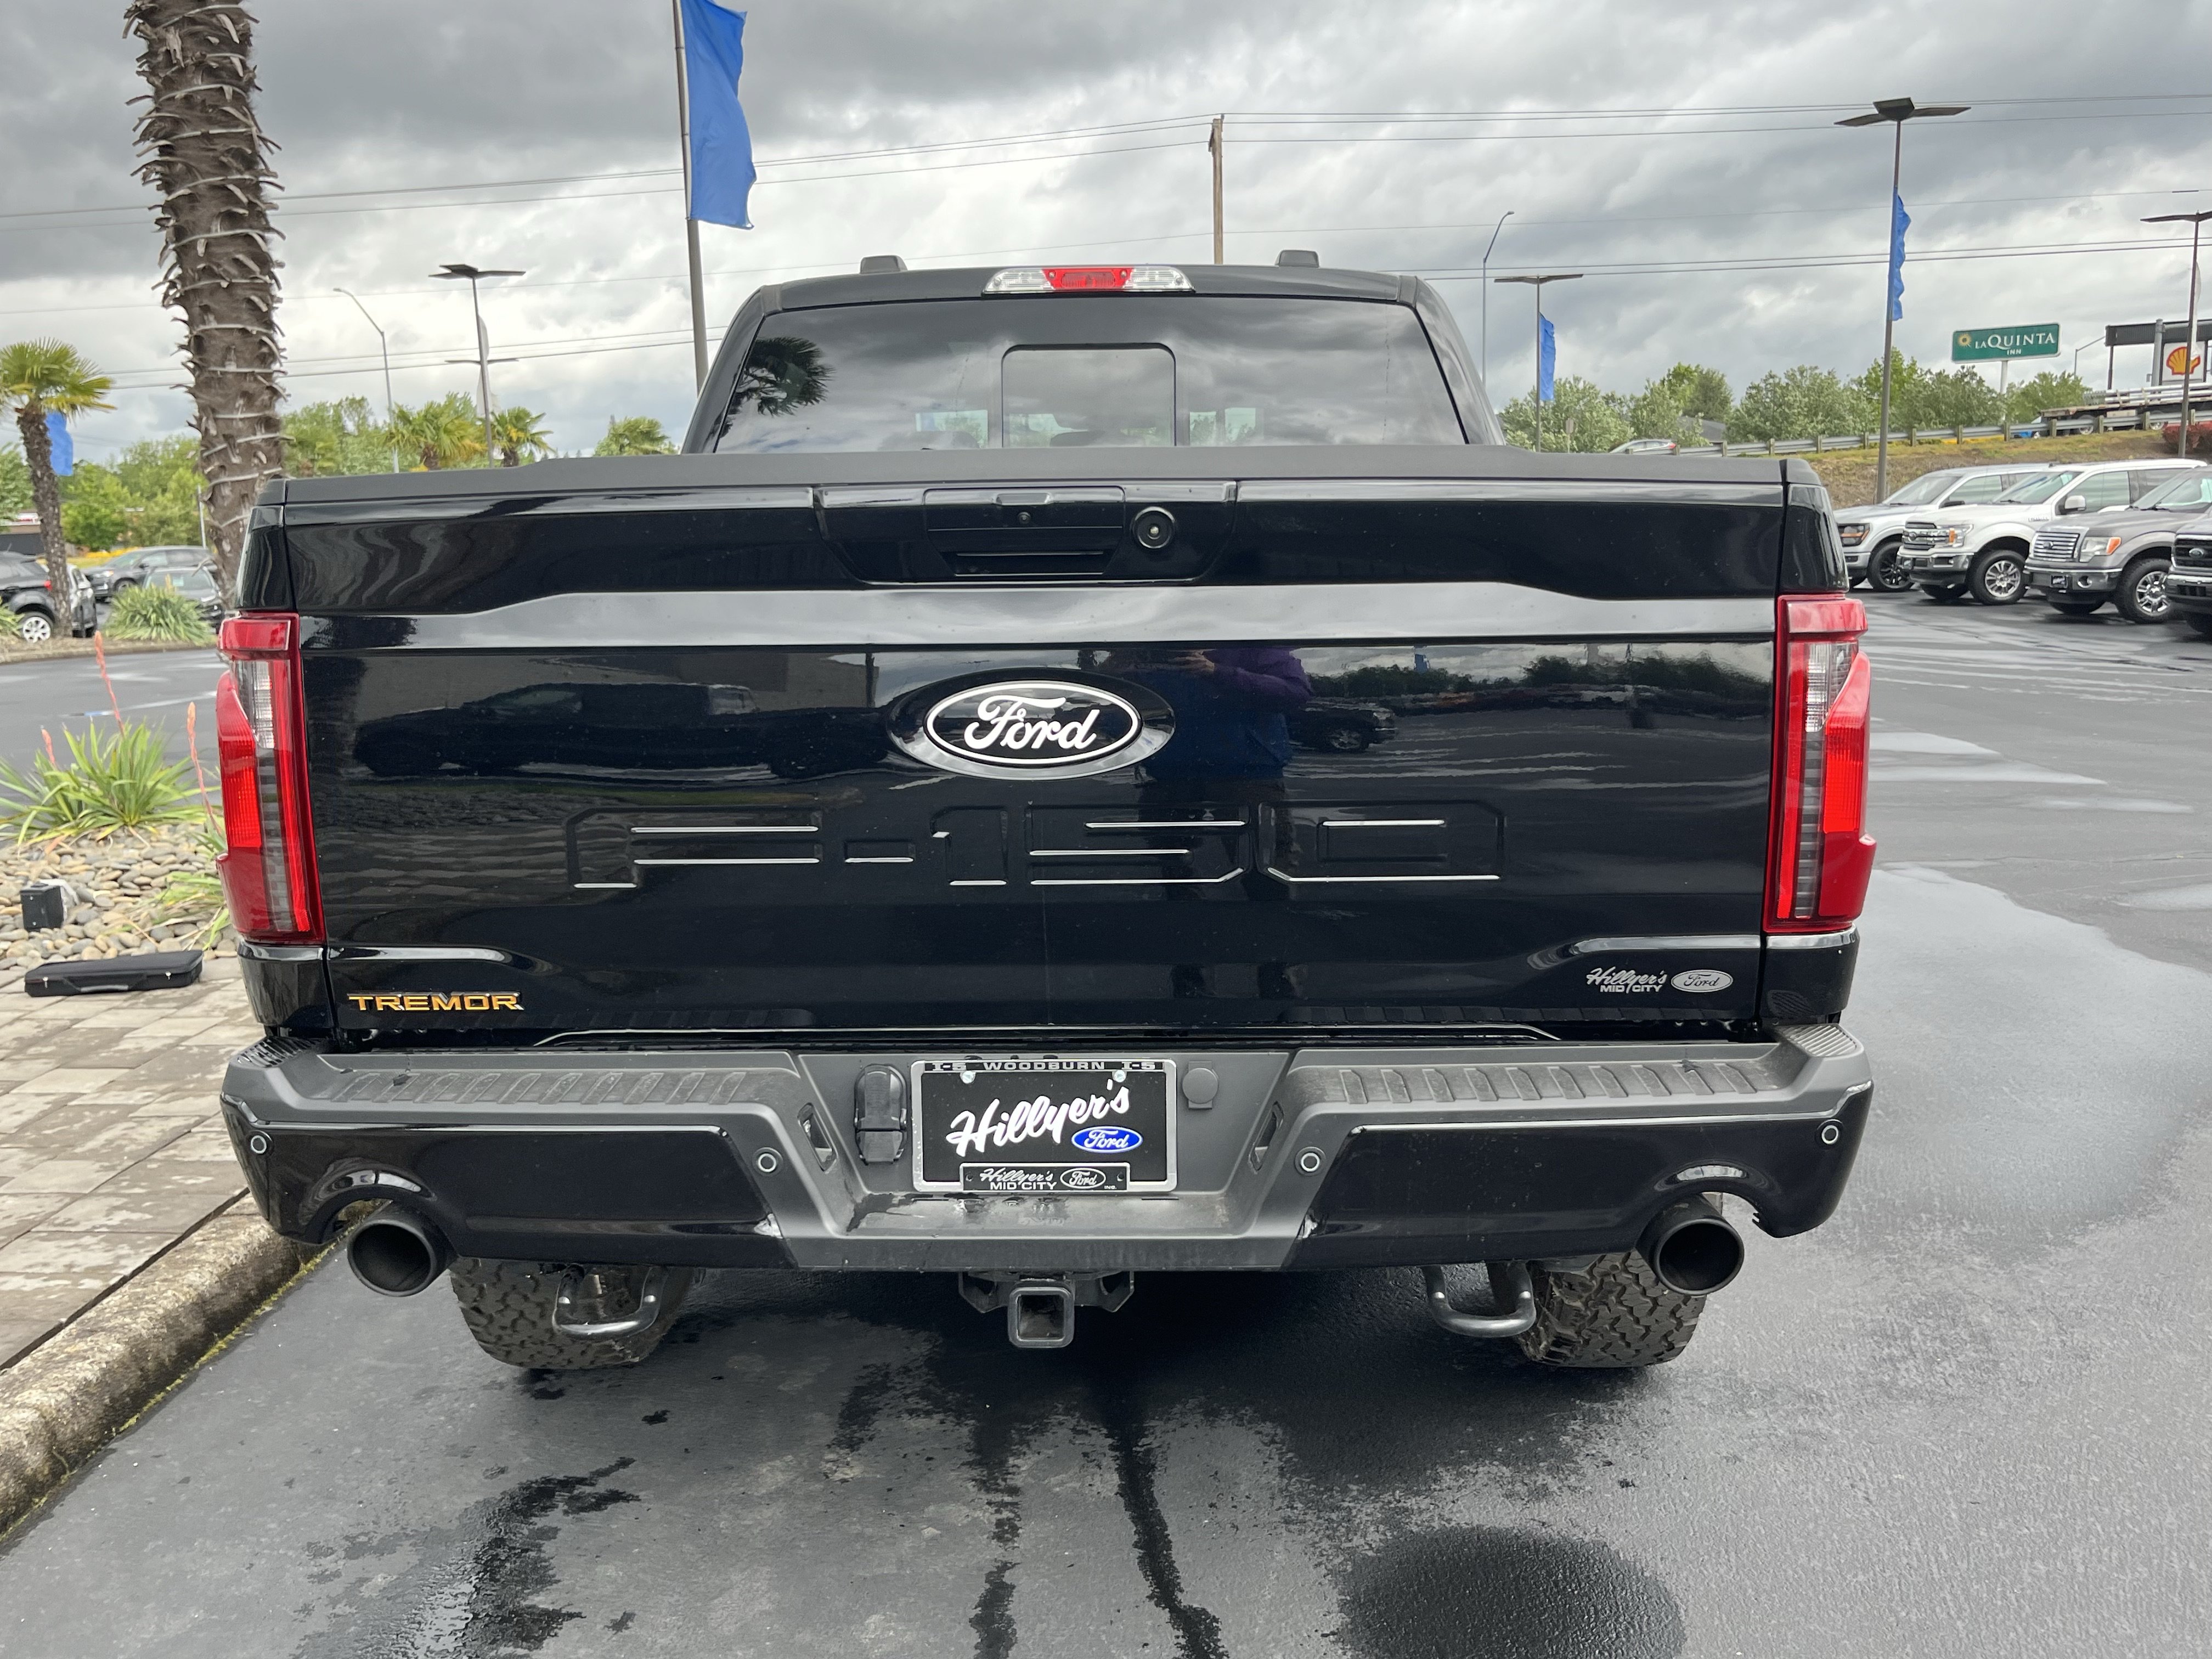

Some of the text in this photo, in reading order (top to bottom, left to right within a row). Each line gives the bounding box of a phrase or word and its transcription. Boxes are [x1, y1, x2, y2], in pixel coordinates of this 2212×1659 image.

[1975, 332, 2056, 350] LA QUINTA
[964, 695, 1100, 750] Ford
[566, 799, 1505, 889] F-150
[1586, 966, 1720, 994] Hillyer's Ford
[347, 991, 524, 1011] TREMOR
[932, 1061, 1156, 1071] I-5 WOODBURN I-5
[946, 1079, 1130, 1157] Hillyer's
[1083, 1130, 1130, 1149] Ford
[979, 1167, 1054, 1185] Hillyer's
[1069, 1171, 1097, 1186] Ford
[990, 1181, 1057, 1190] MID CITY
